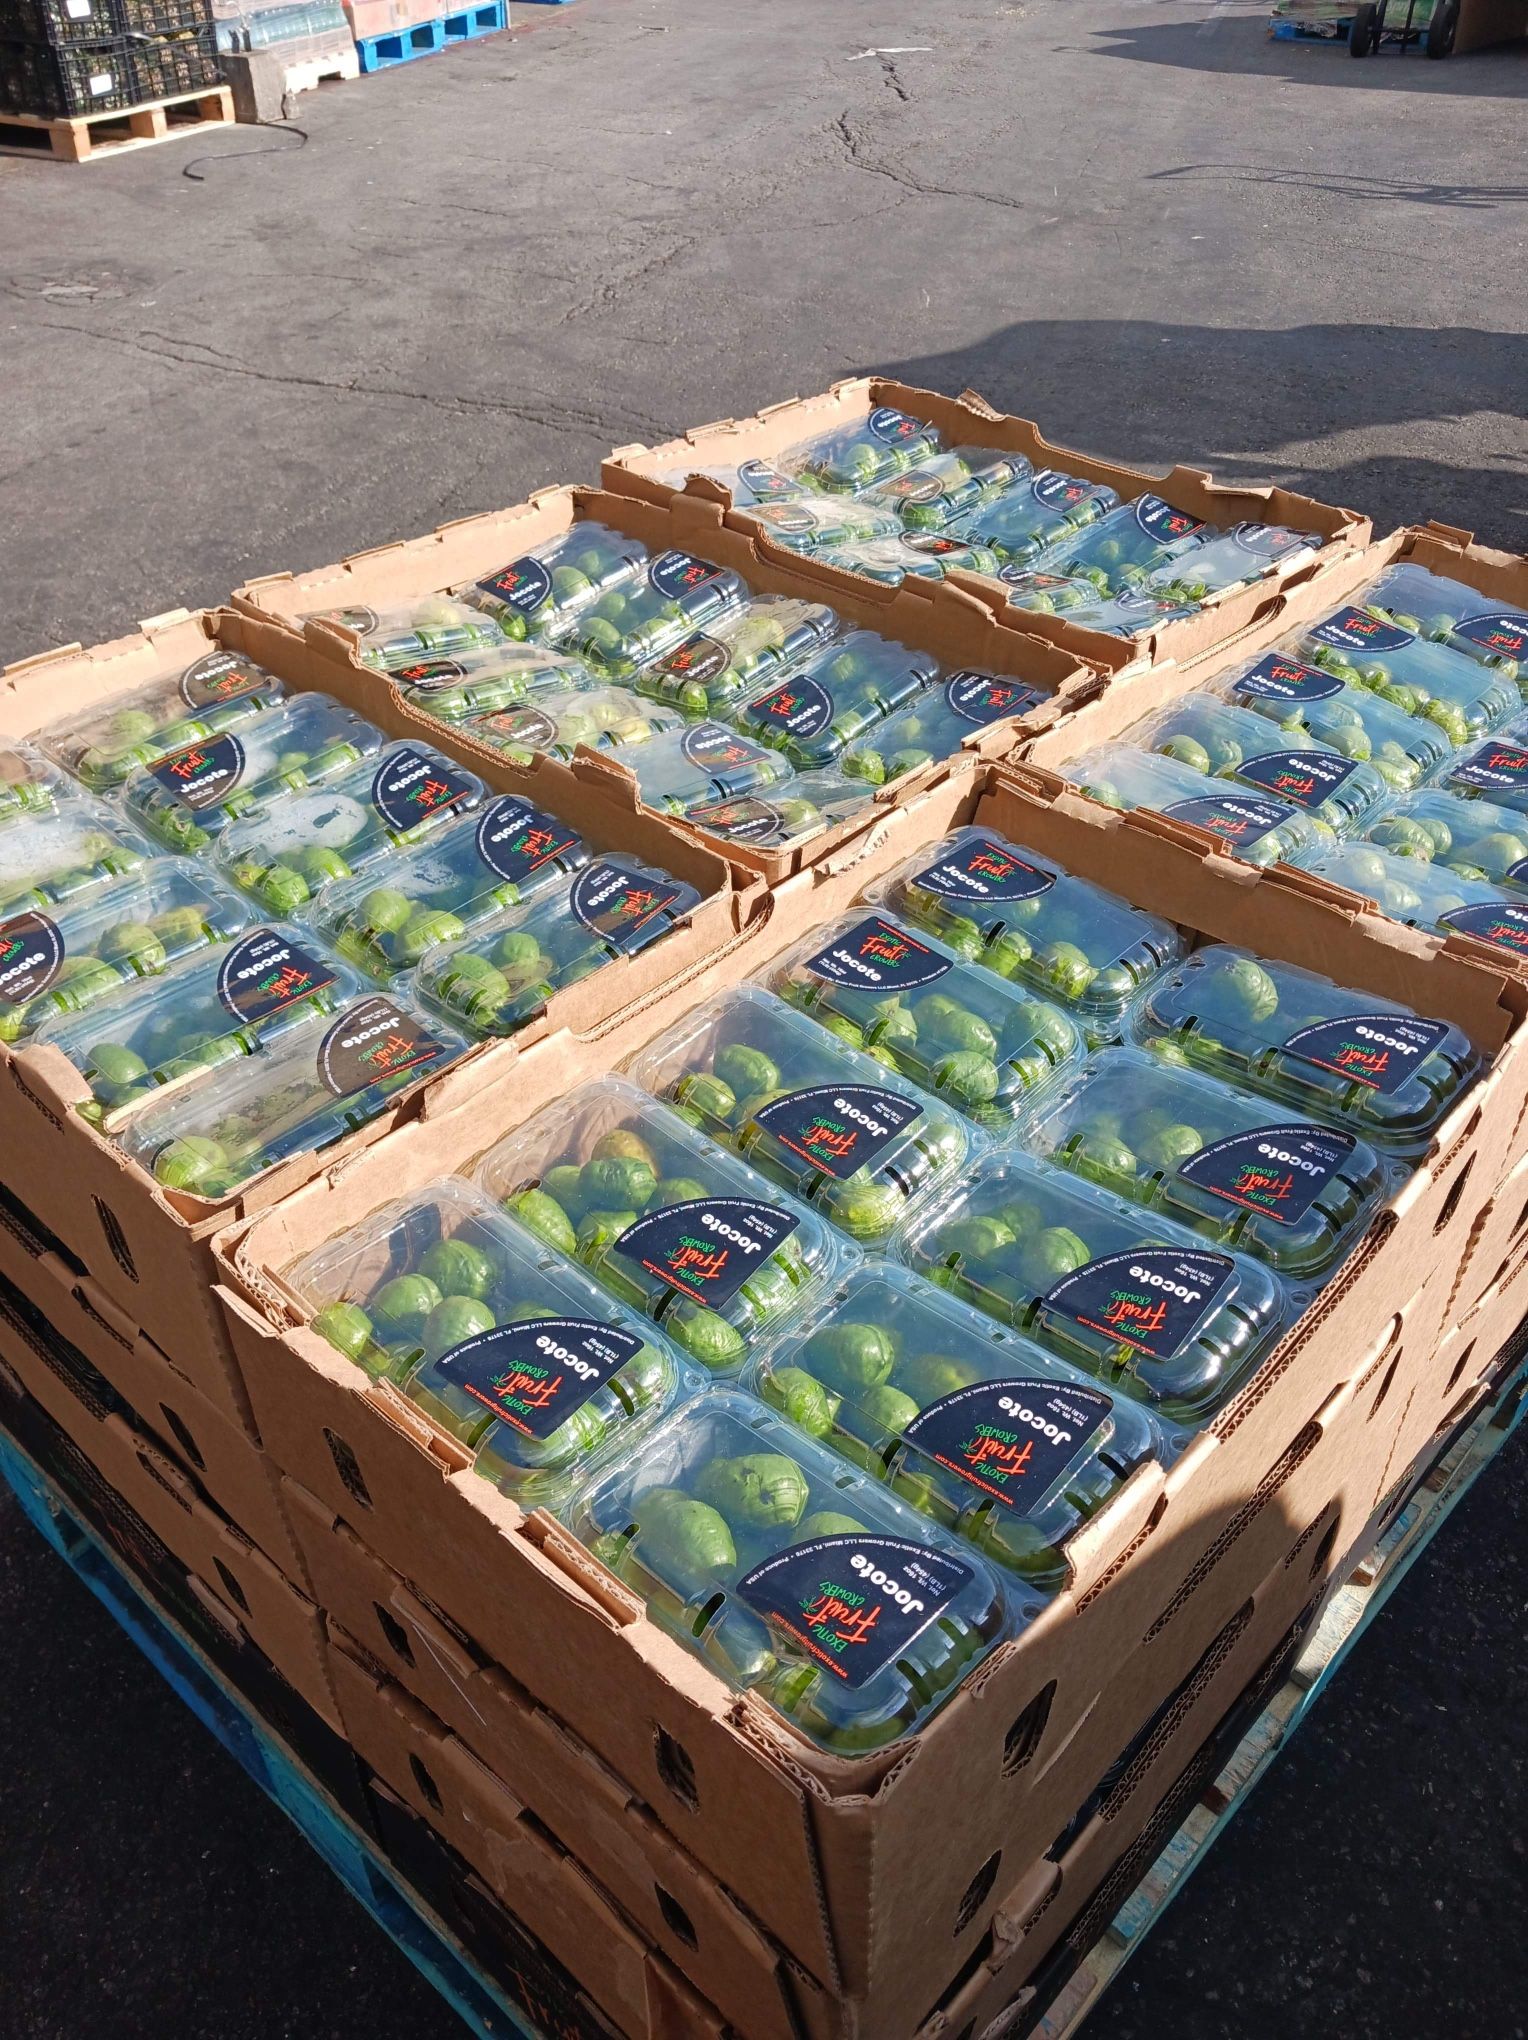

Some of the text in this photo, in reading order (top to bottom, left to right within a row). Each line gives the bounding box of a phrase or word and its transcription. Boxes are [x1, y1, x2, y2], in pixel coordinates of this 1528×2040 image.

[1325, 625, 1366, 646] Jocote
[194, 661, 238, 680] Jocote
[1271, 666, 1307, 682] Fruit
[960, 679, 992, 701] Jocote
[1252, 675, 1295, 696] Jocote
[787, 705, 822, 728] Jocote
[695, 735, 732, 749] Jocote
[171, 750, 207, 779] Fruit
[1289, 758, 1336, 782] Jocote
[1466, 766, 1514, 783] Jocote
[180, 768, 228, 793] Jocote
[388, 766, 431, 791] Jocote
[1275, 775, 1316, 795] Fruit
[728, 818, 769, 833] Jocote
[1222, 802, 1272, 825] Jocote
[490, 814, 534, 843] Jocote
[969, 856, 1011, 875] Fruit
[587, 876, 629, 907] Jocote
[943, 866, 989, 893] Jocote
[861, 937, 907, 959] Fruit
[0, 952, 45, 986] ocote
[237, 949, 290, 980] Jocote
[833, 950, 881, 981] Jocote
[269, 966, 311, 999] Fruit
[341, 1016, 400, 1049] Jocote
[1356, 1026, 1418, 1055] Jocote
[370, 1035, 414, 1069] Fruit
[1339, 1051, 1387, 1071] Fruit
[834, 1098, 888, 1136] Jocote
[804, 1127, 856, 1155] Fruit
[1258, 1144, 1325, 1176] Jocote
[1237, 1174, 1291, 1197] Fruit
[678, 1236, 715, 1252] GROWERS
[702, 1214, 761, 1254] Jocote
[670, 1248, 727, 1277] Fruit
[676, 1268, 704, 1287] EXOTIC
[1129, 1266, 1200, 1303] Jocote
[1110, 1289, 1151, 1304] GROWERS
[1107, 1302, 1165, 1329] Fruit
[1116, 1323, 1147, 1338] EXOTIC
[507, 1360, 549, 1378] GROWERS
[536, 1336, 599, 1380] Jocote
[496, 1374, 561, 1405] Fruit
[501, 1395, 533, 1415] EXOTIC
[975, 1424, 1018, 1443] GROWERS
[999, 1397, 1071, 1445] Jocote
[966, 1438, 1032, 1473] Fruit
[975, 1463, 1008, 1484] EXOTIC
[818, 1579, 865, 1606] GROWERS
[851, 1555, 924, 1614] Jocote
[804, 1598, 880, 1641] Fruit
[812, 1625, 848, 1653] EXOTIC
